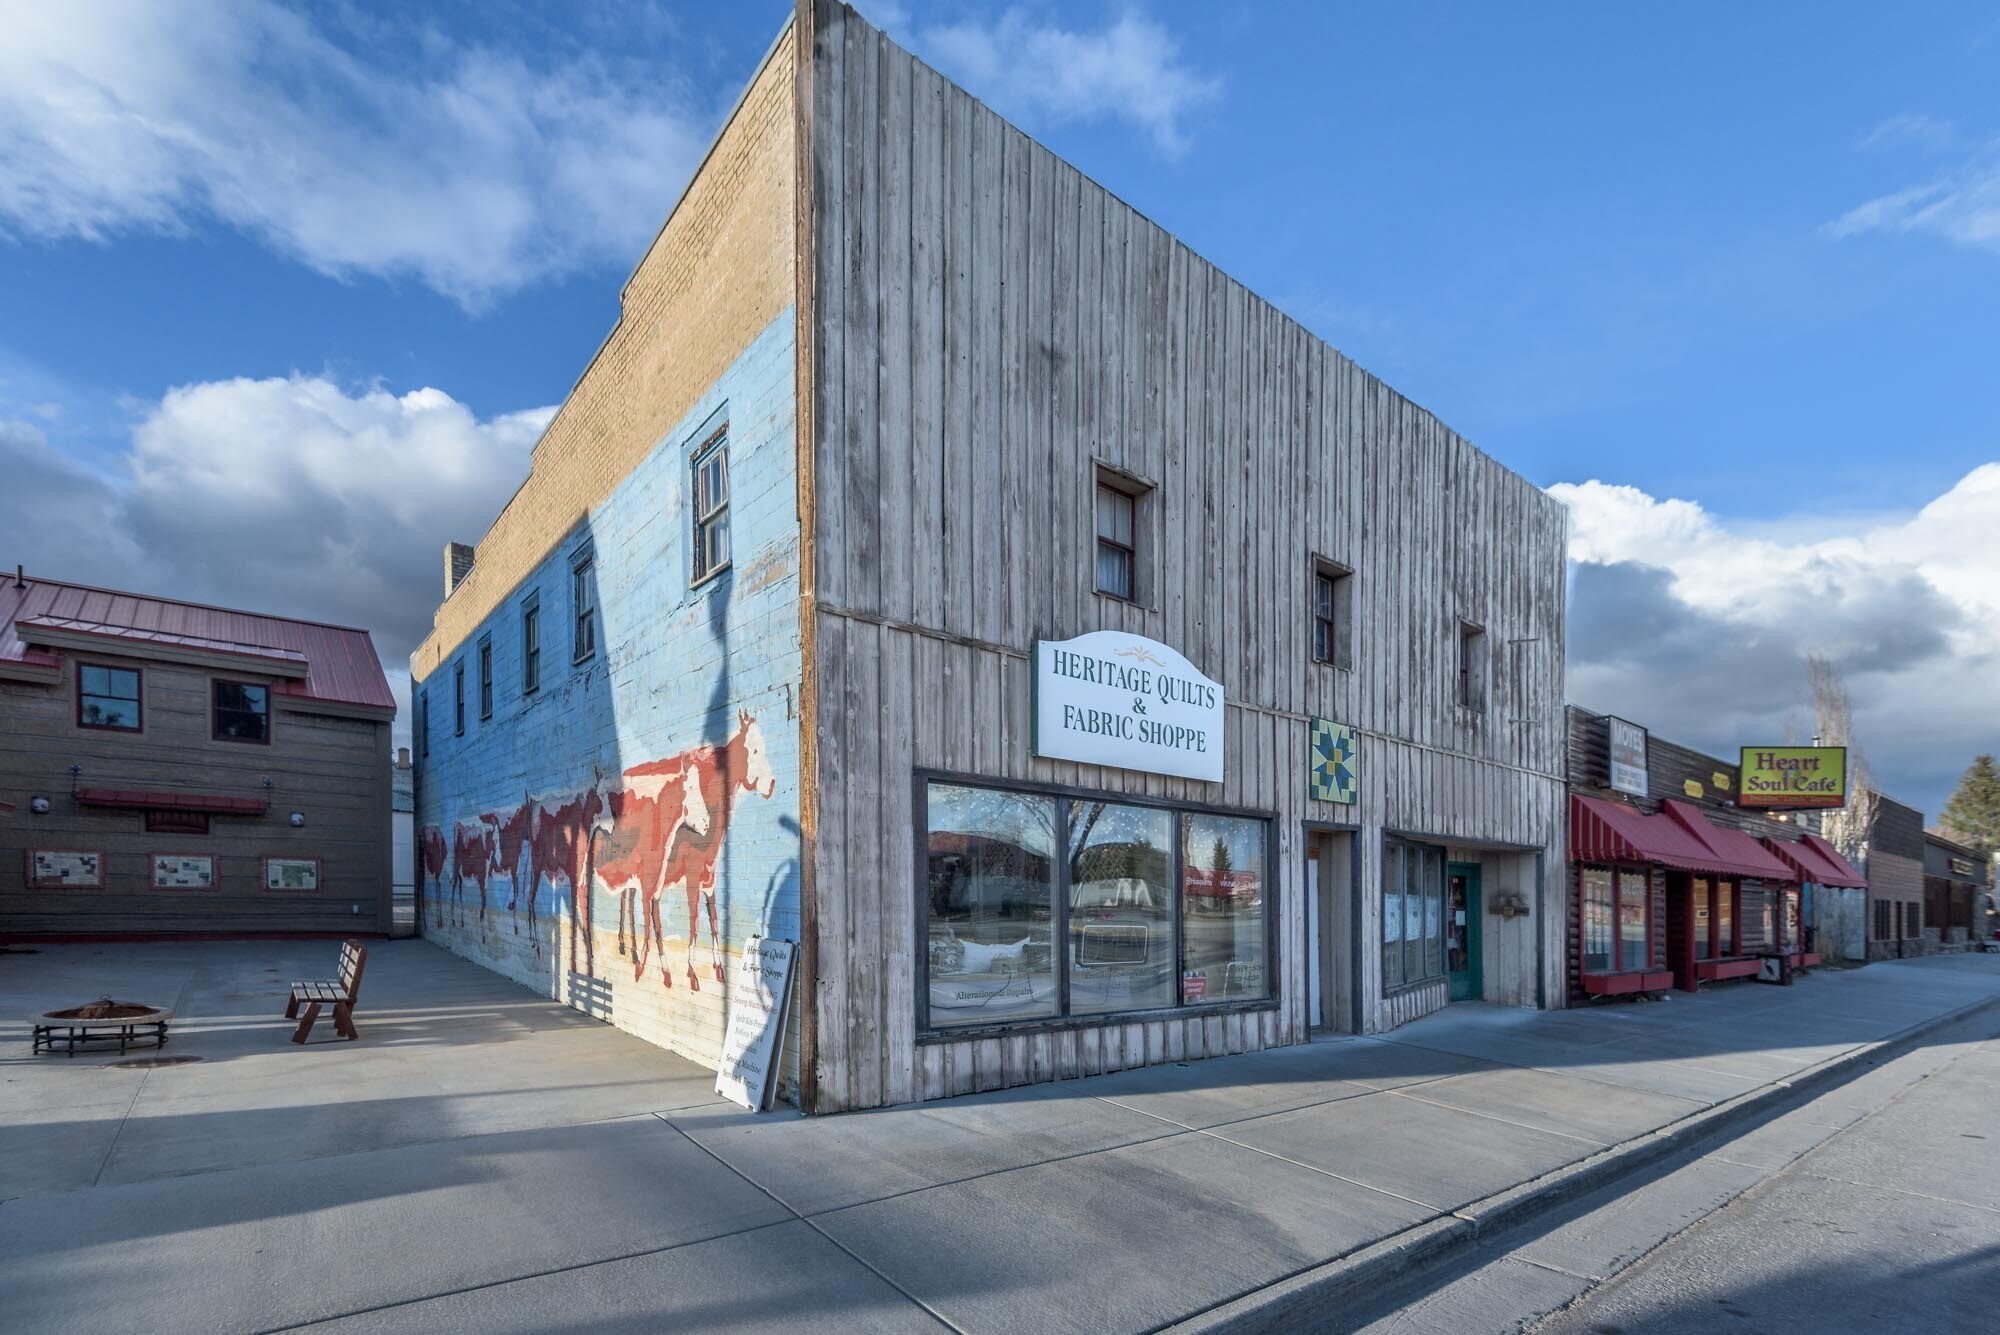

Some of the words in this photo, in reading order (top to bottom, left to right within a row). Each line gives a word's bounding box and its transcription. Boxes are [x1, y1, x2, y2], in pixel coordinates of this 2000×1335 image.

[1053, 649, 1151, 694] HERITAGE
[1158, 674, 1215, 710] QUILTS
[1132, 697, 1147, 715] &
[1063, 704, 1133, 741] FABRIC
[1138, 719, 1207, 753] SHOPPE
[1755, 752, 1821, 770] Heart
[1747, 775, 1788, 791] Soul
[956, 988, 997, 1000] Alteration
